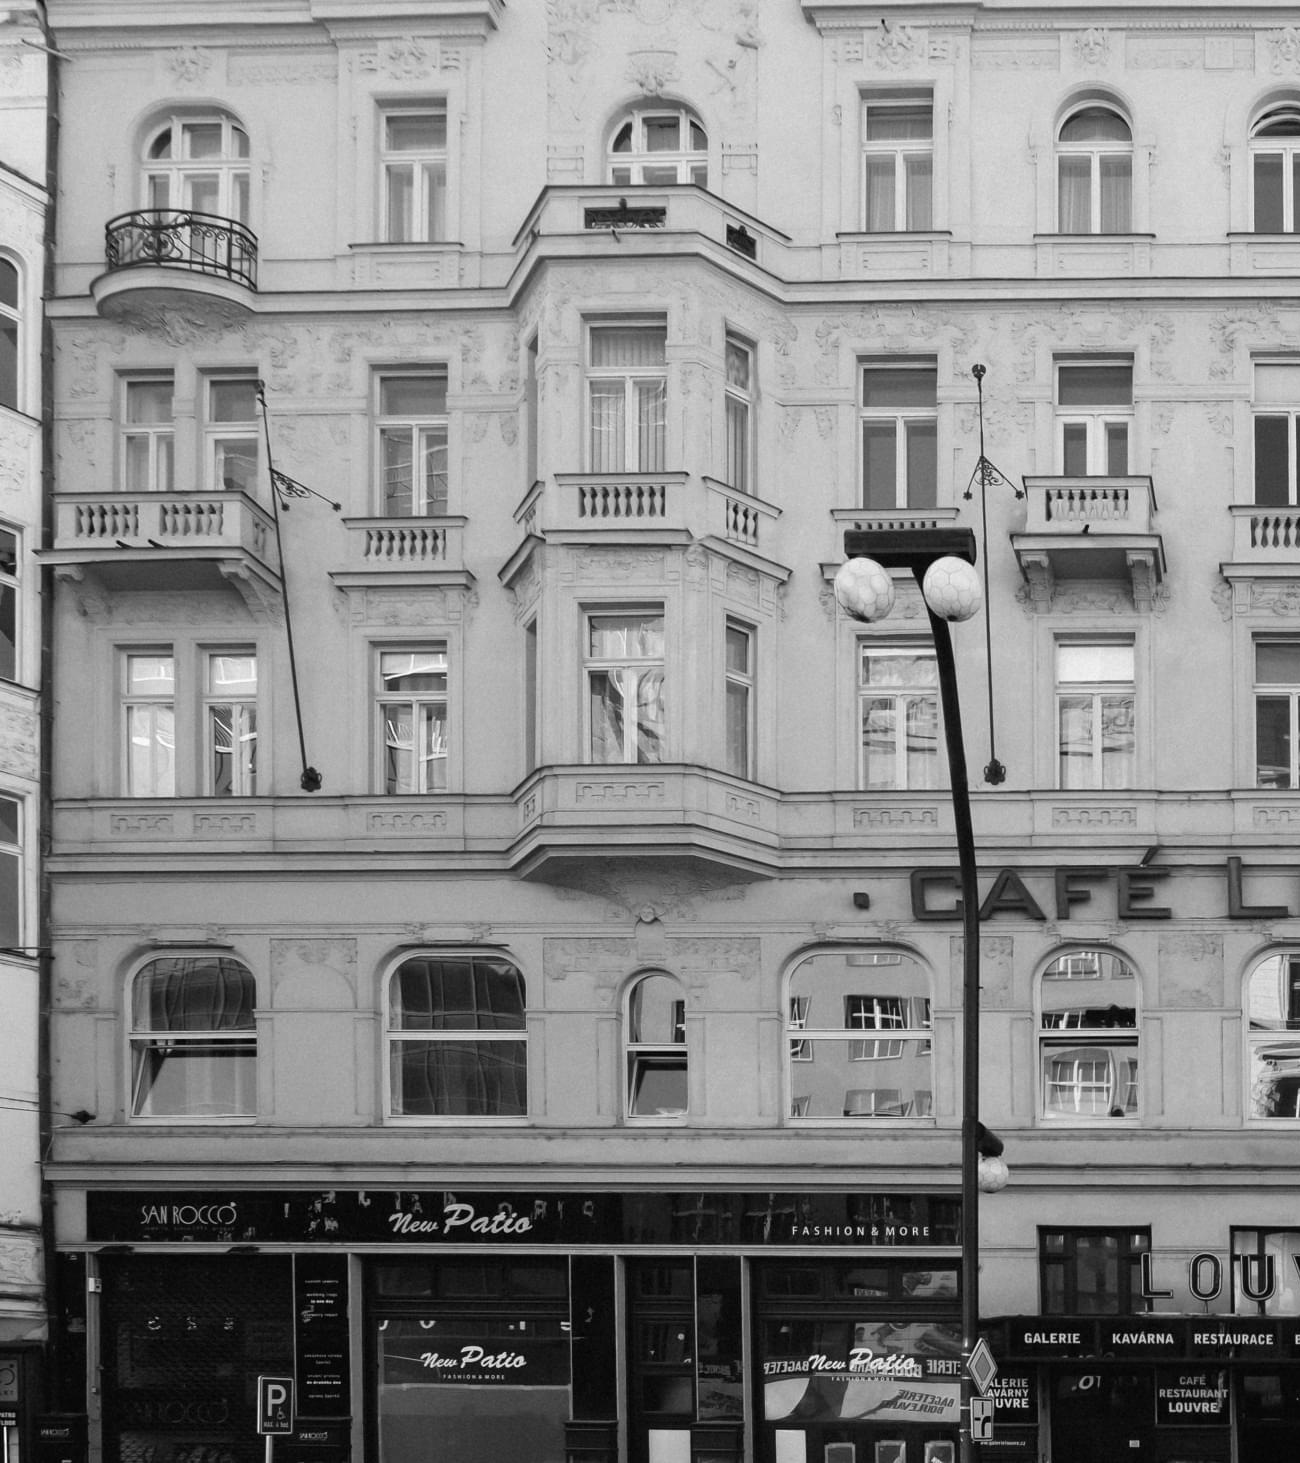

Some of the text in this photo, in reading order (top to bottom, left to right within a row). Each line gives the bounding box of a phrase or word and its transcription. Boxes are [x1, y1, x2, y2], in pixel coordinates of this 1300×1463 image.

[910, 845, 1172, 921] CAFÉ
[140, 1203, 237, 1225] SAN ROCCO
[388, 1212, 439, 1233] New
[443, 1203, 534, 1234] Patio
[791, 1226, 930, 1236] FASHION & MORE
[1024, 1332, 1081, 1344] GALERIE
[1112, 1330, 1174, 1345] KAVÁRNA
[1194, 1333, 1274, 1346] RESTAURACE
[420, 1345, 527, 1369] New Patio
[808, 1347, 915, 1372] New Patio
[989, 1377, 1029, 1388] ALERIE
[1179, 1373, 1207, 1385] CAFÉ
[986, 1387, 1030, 1398] AVÁRNY
[1159, 1388, 1229, 1399] RESTAURANT
[267, 1384, 287, 1416] P
[994, 1398, 1030, 1409] UVRE
[1168, 1402, 1219, 1413] LOUVRE
